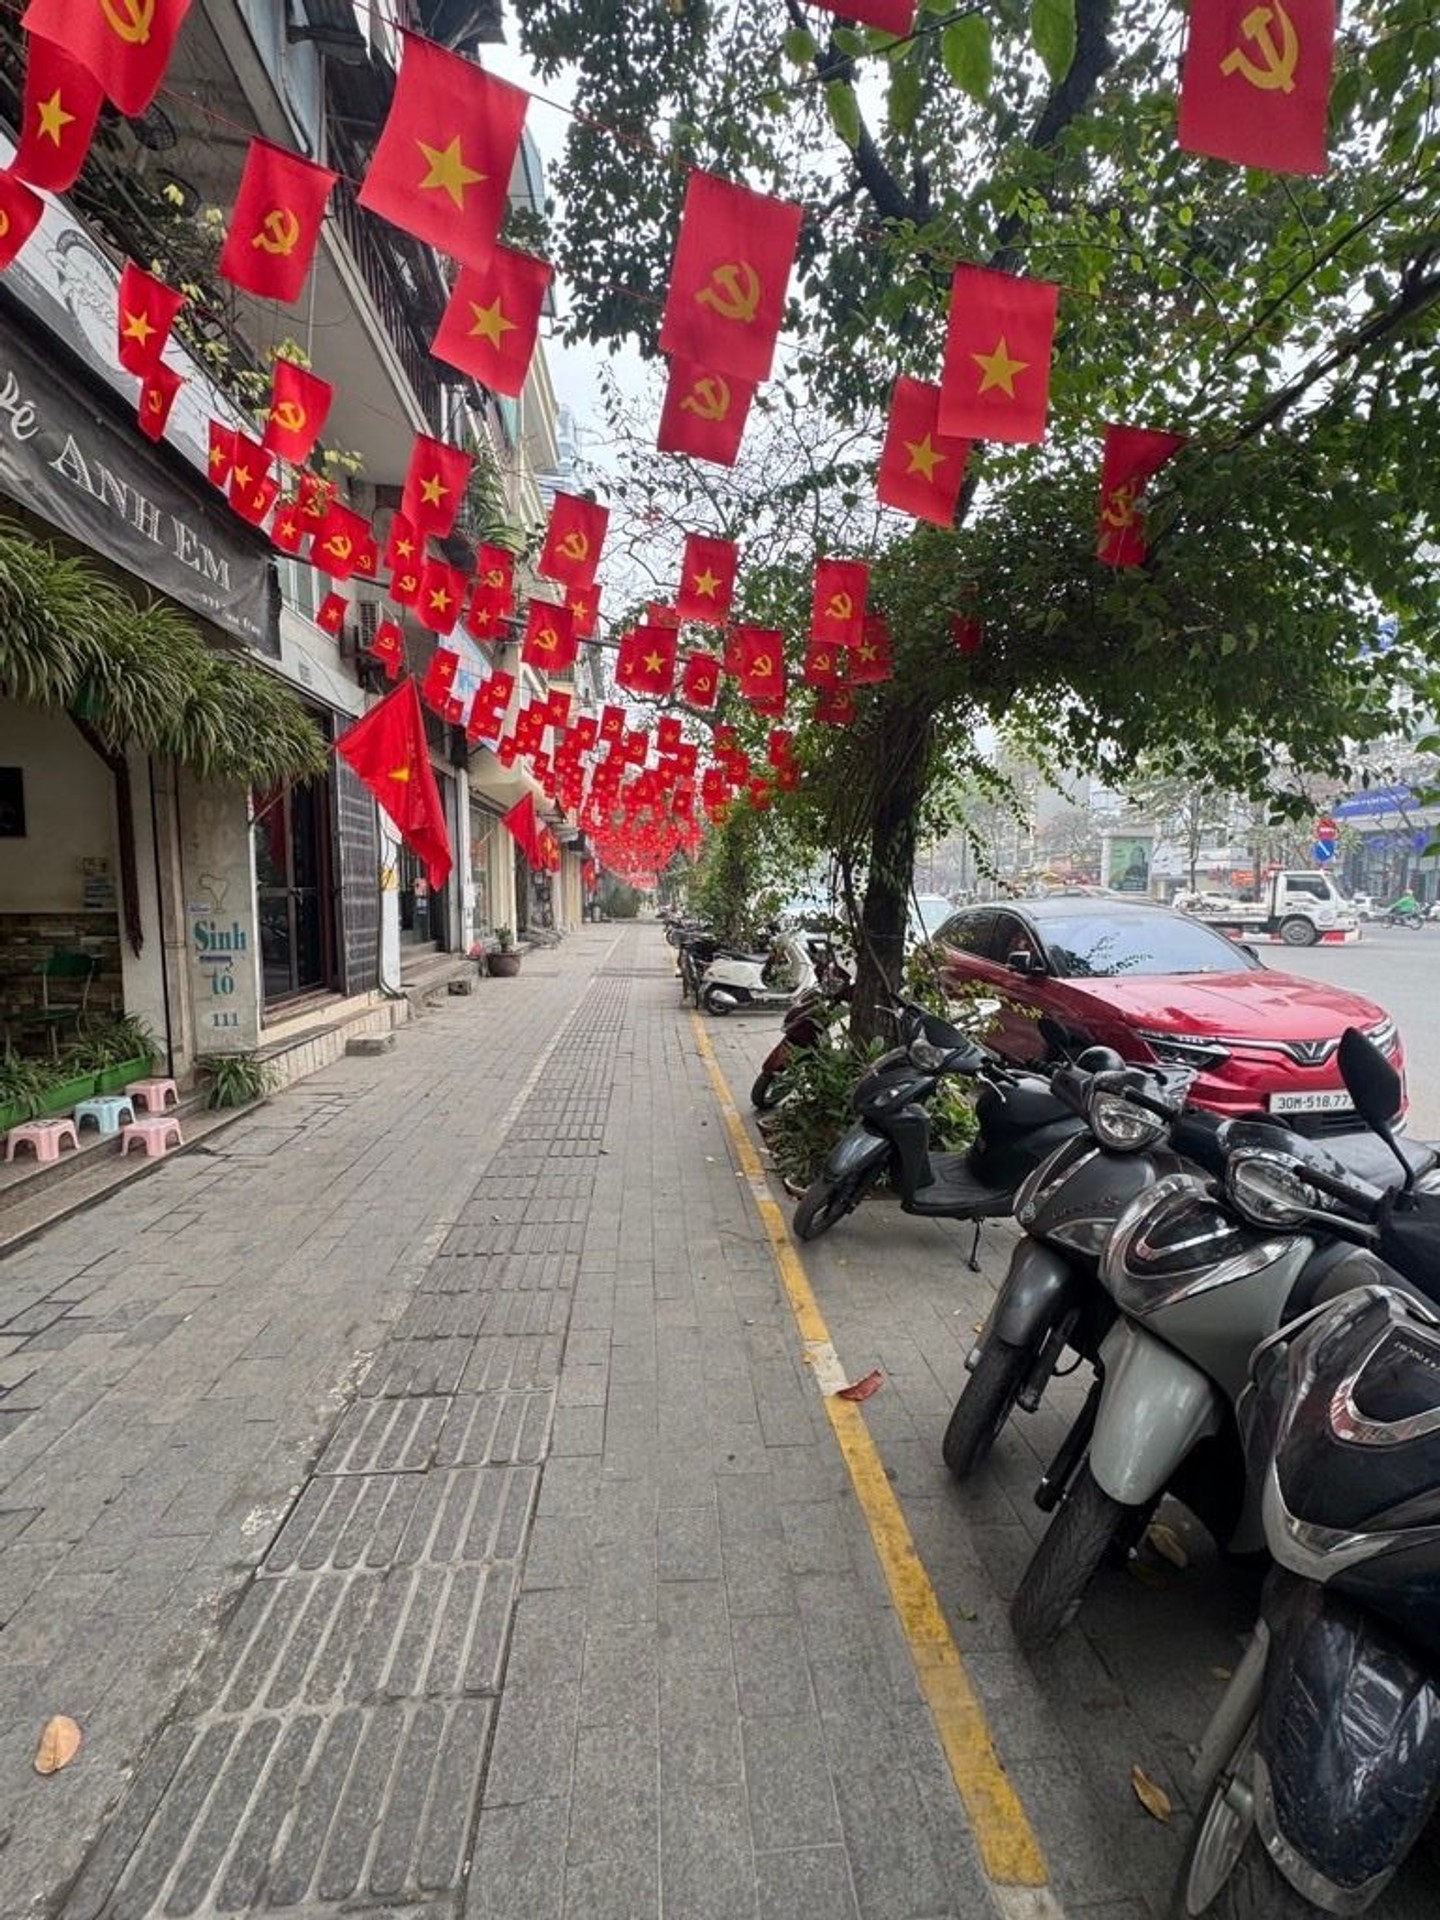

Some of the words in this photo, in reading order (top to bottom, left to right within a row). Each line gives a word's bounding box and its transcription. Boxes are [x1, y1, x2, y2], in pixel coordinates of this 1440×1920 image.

[48, 435, 164, 546] ANH
[171, 514, 231, 591] EM
[193, 920, 246, 951] Sinh
[212, 1012, 239, 1027] 111
[1278, 1094, 1354, 1109] 30M-518.77
